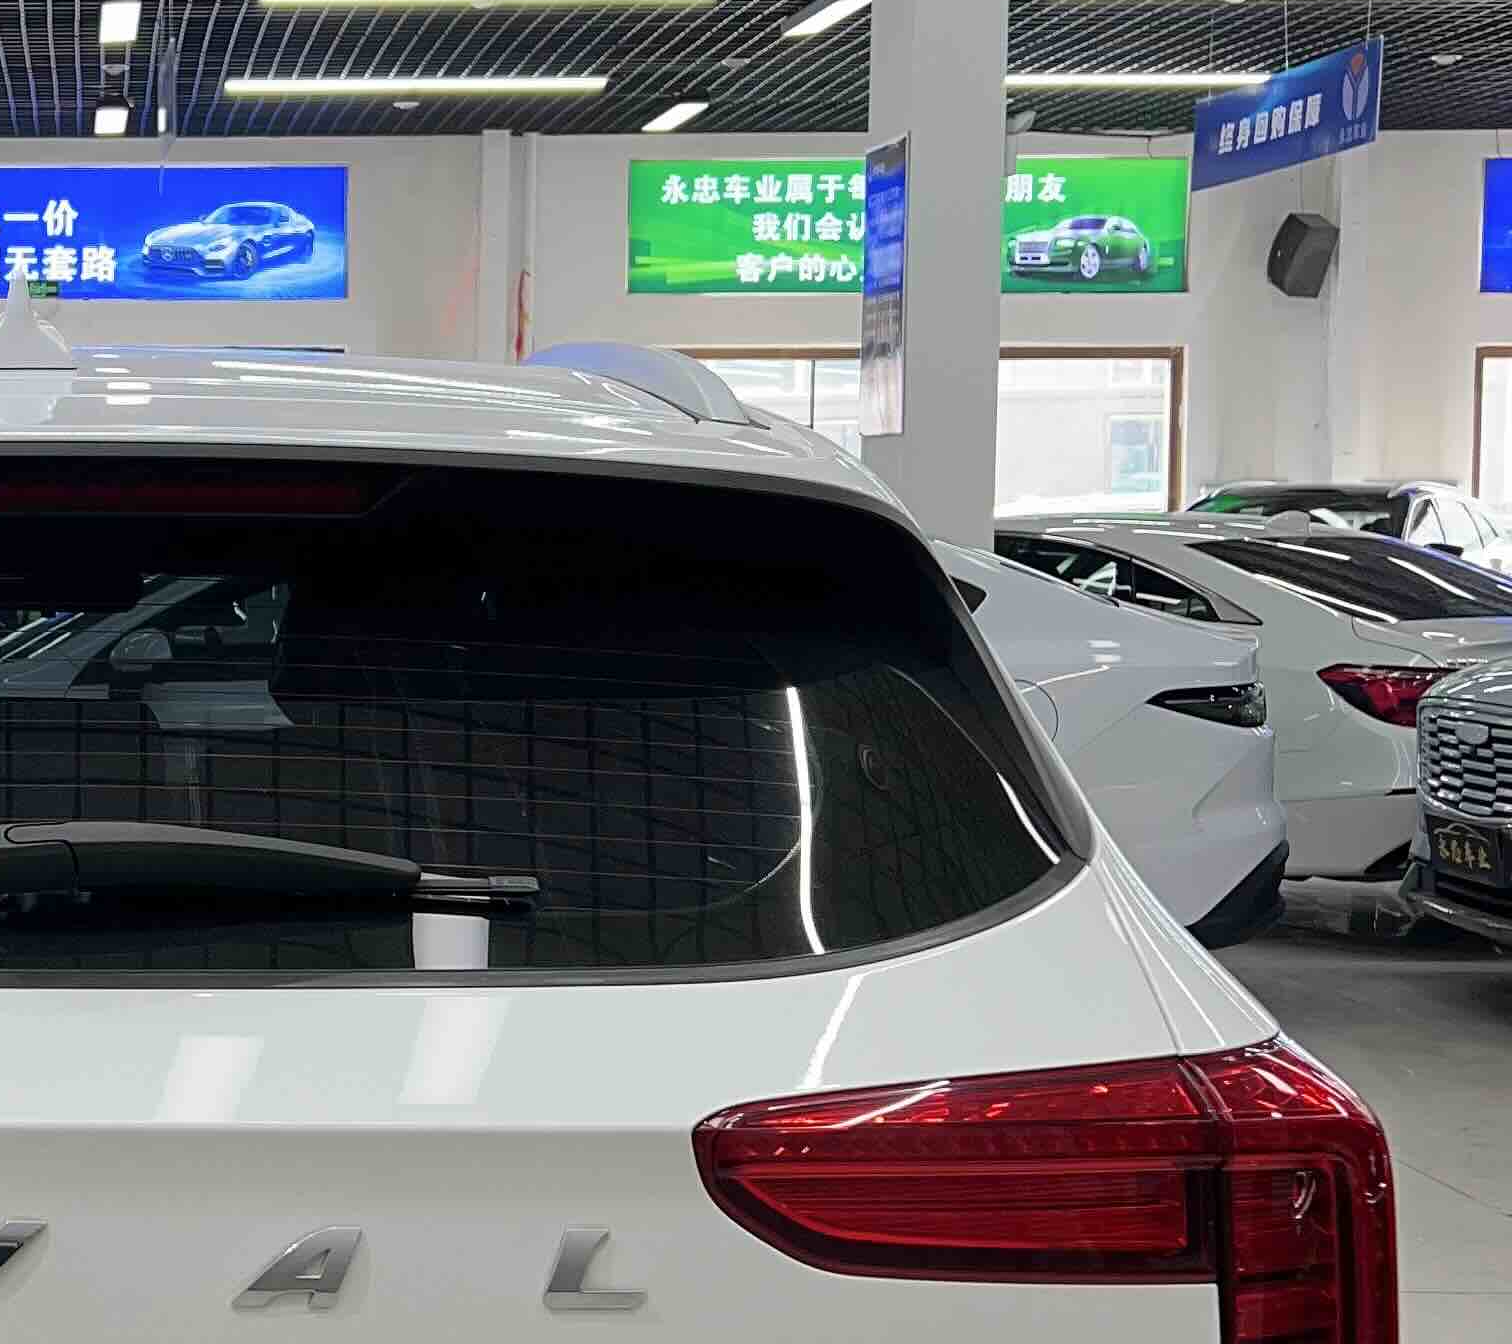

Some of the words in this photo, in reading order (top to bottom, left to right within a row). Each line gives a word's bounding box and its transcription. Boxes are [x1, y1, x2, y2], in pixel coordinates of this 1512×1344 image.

[1005, 173, 1066, 202] 朋友
[736, 253, 864, 282] 客户的心
